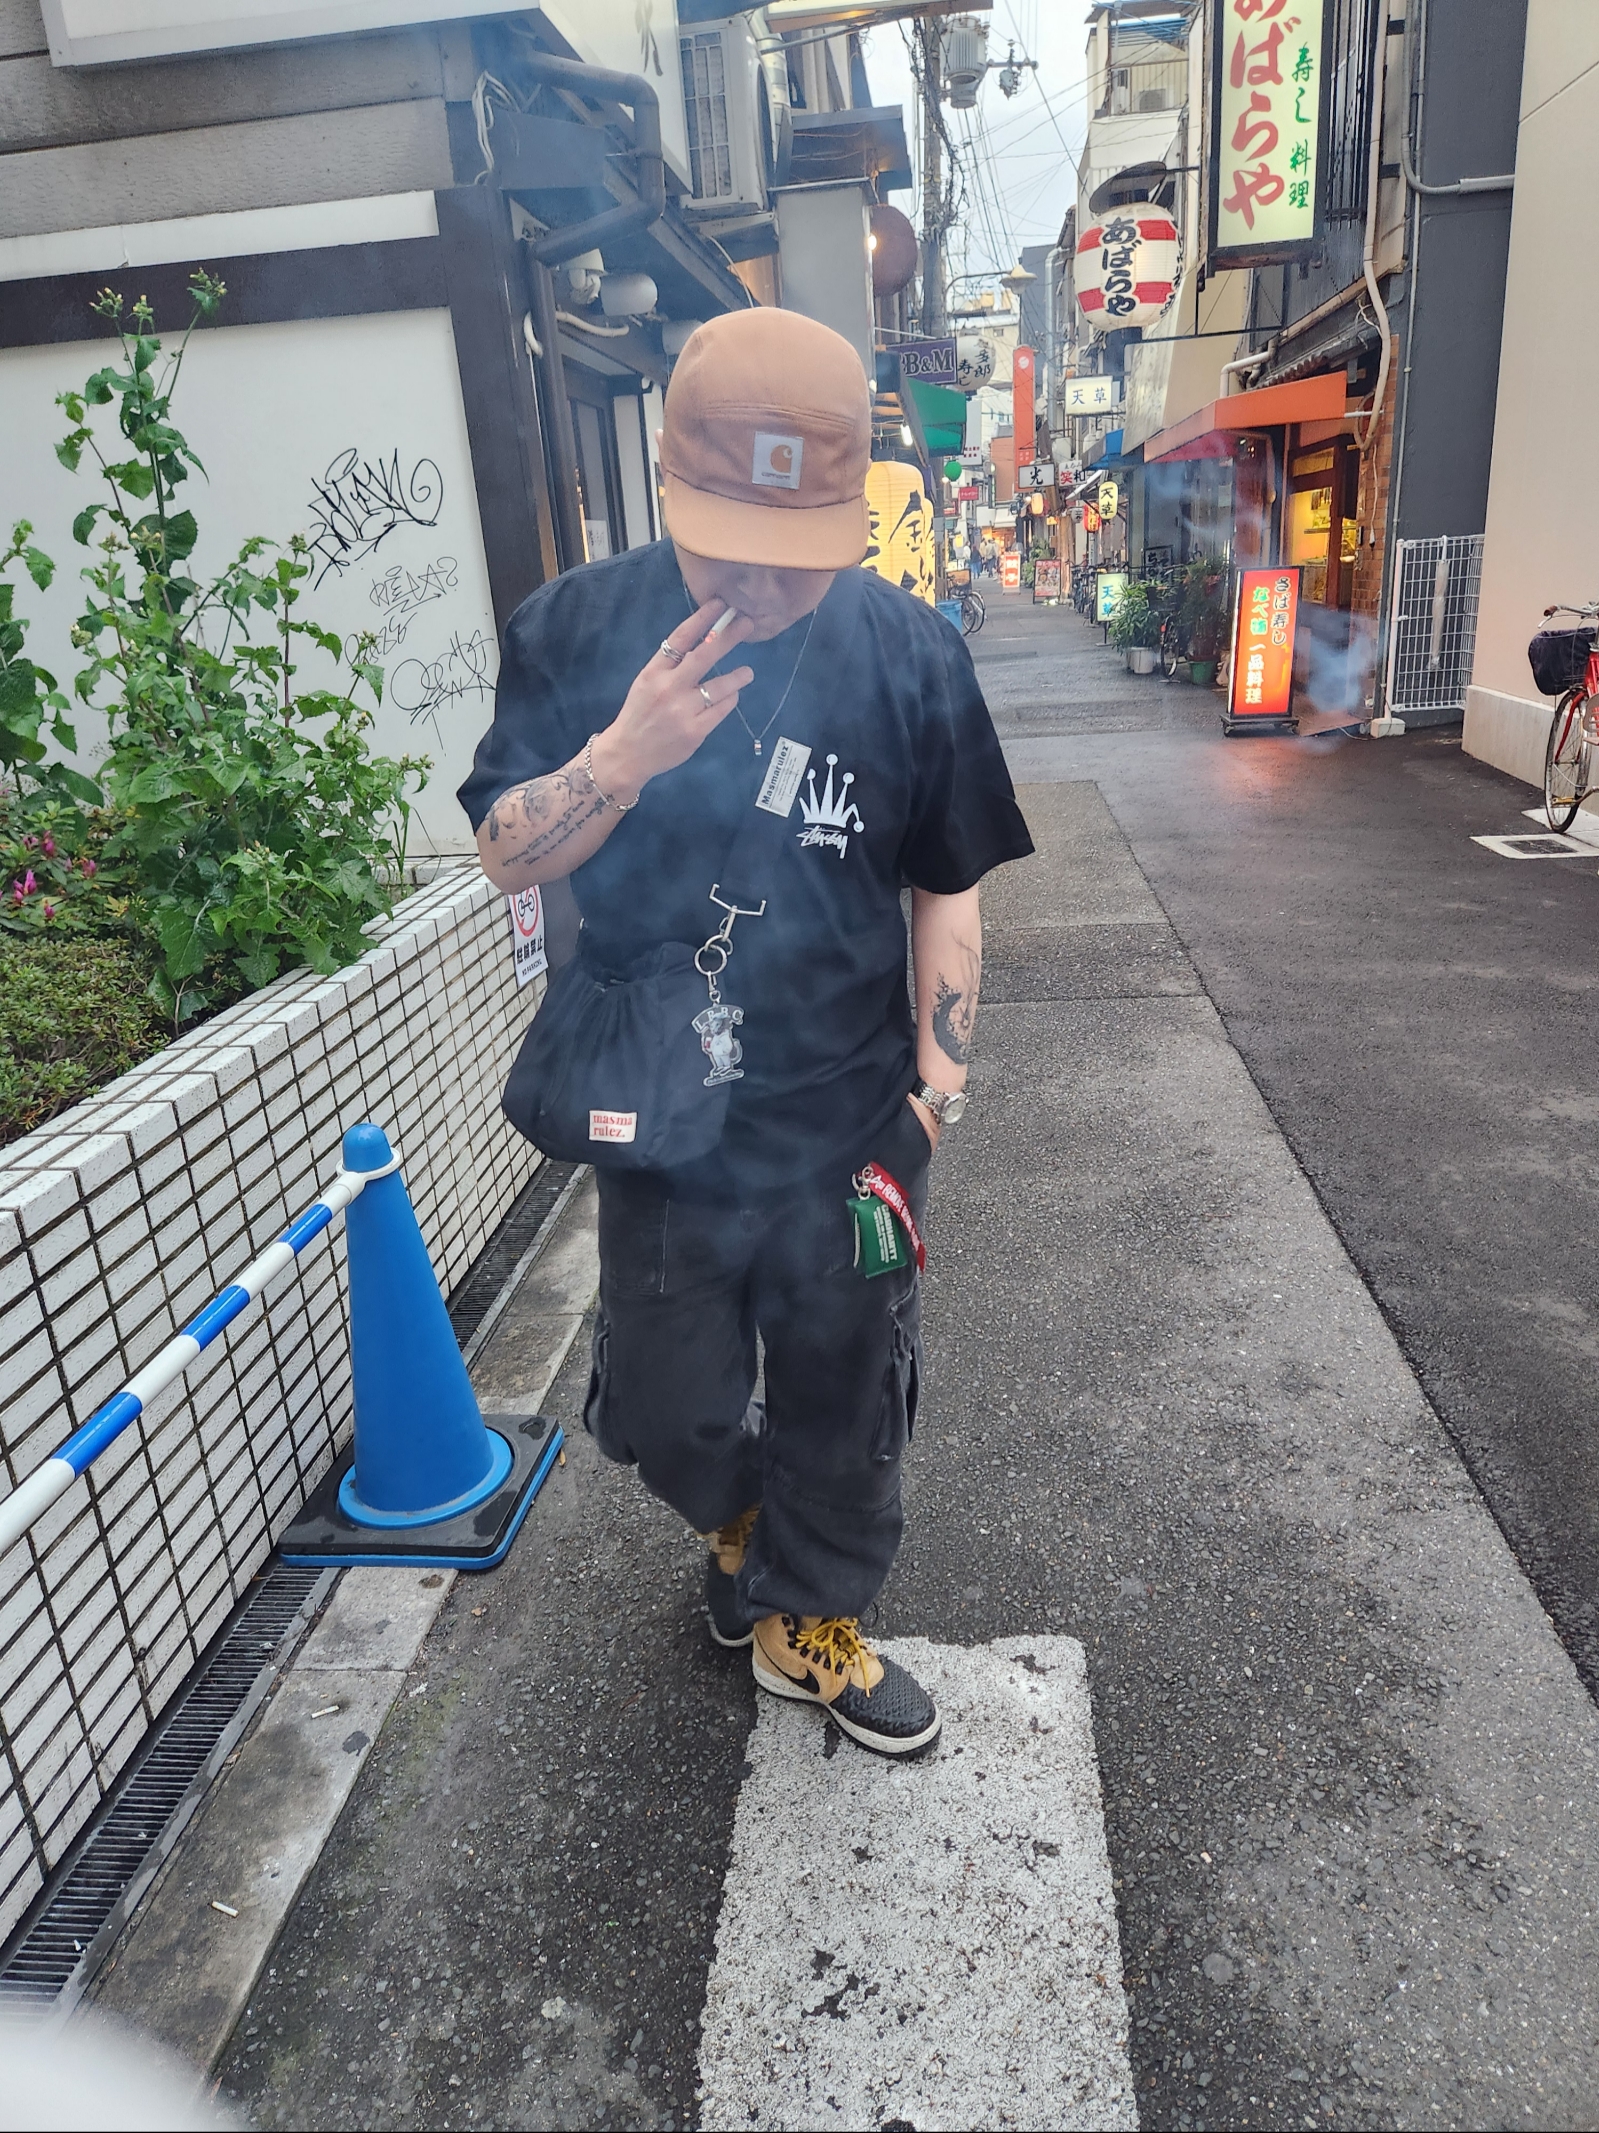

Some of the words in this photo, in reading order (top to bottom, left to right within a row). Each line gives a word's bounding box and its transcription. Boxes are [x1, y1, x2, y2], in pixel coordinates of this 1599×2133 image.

[1102, 217, 1142, 317] あばらや
[1071, 386, 1107, 405] 天草
[1030, 466, 1043, 485] 光
[1060, 468, 1086, 485] 笑和
[1100, 487, 1115, 516] 天草
[1272, 577, 1290, 646] さば寿し
[593, 1115, 633, 1126] masma
